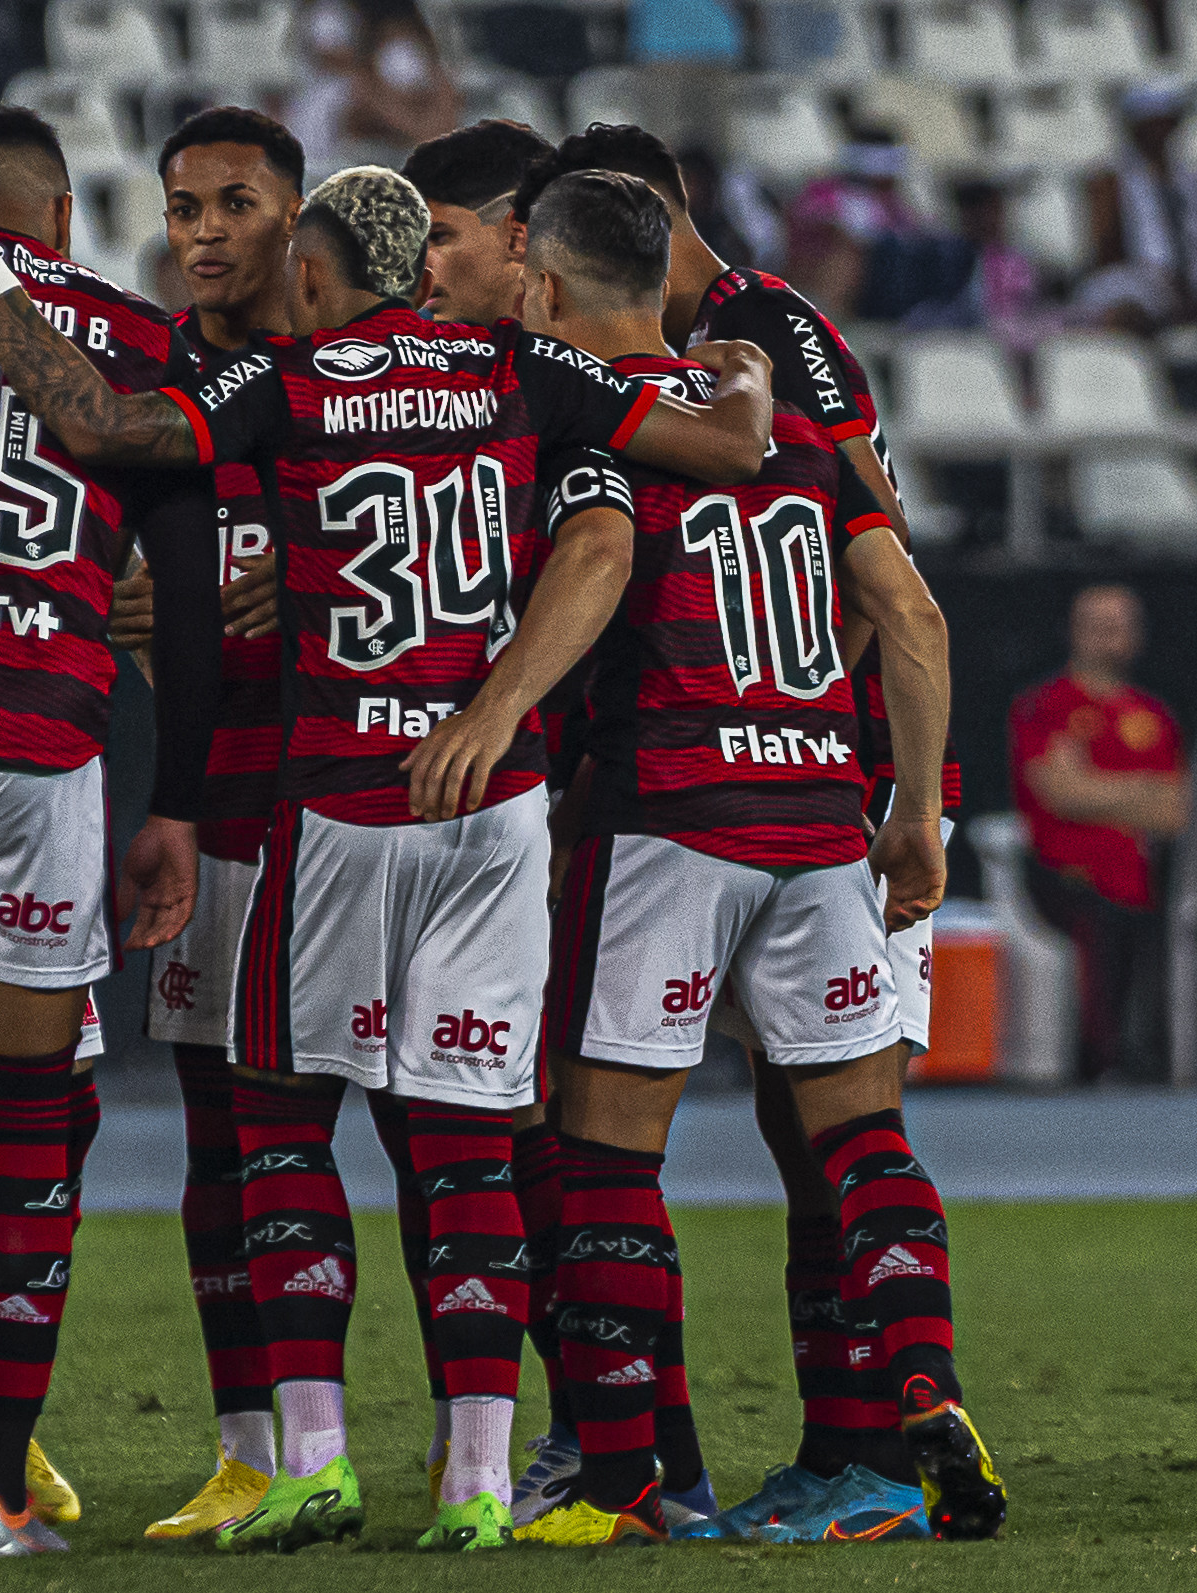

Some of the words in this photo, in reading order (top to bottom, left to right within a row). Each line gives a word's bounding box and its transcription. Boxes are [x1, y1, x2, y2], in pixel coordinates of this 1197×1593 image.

[13, 257, 67, 284] livre
[88, 316, 116, 358] B.
[393, 334, 496, 357] mercado
[398, 346, 450, 372] livre
[529, 337, 631, 393] HAVAN
[787, 314, 845, 413] HAVAN
[10, 411, 26, 440] TIM
[486, 487, 497, 518] TIM
[560, 466, 601, 506] C
[388, 496, 403, 525] TIM
[717, 526, 731, 555] TIM
[807, 527, 819, 556] TIM
[317, 454, 516, 671] 34
[680, 494, 846, 700] 10
[357, 697, 462, 738] FlaT
[824, 964, 880, 1011] abc
[351, 998, 387, 1040] ab
[432, 1009, 511, 1056] abc
[446, 1054, 507, 1071] construção
